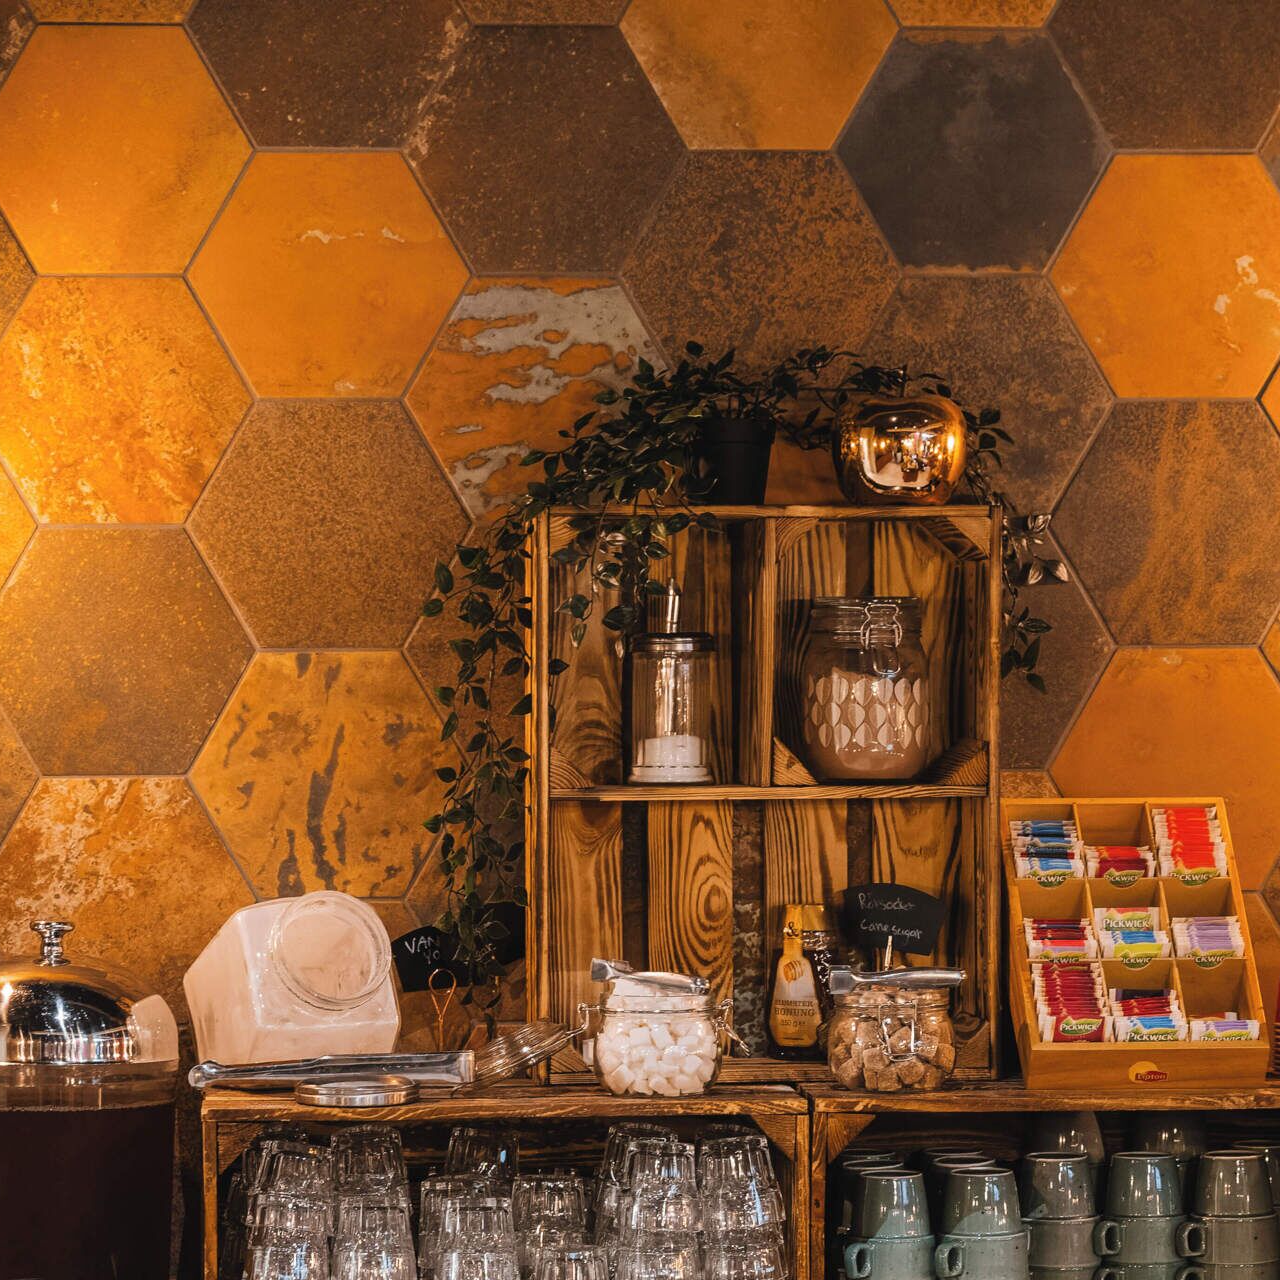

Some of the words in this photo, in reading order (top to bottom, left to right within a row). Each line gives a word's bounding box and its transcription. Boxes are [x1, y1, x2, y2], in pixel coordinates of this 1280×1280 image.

[1103, 918, 1150, 929] PICKWICK
[860, 919, 888, 931] Cane
[891, 925, 923, 942] sugar
[1058, 1023, 1098, 1032] PICKWICK
[1126, 1032, 1174, 1042] PICKWICK
[1137, 1073, 1166, 1081] Lipton
